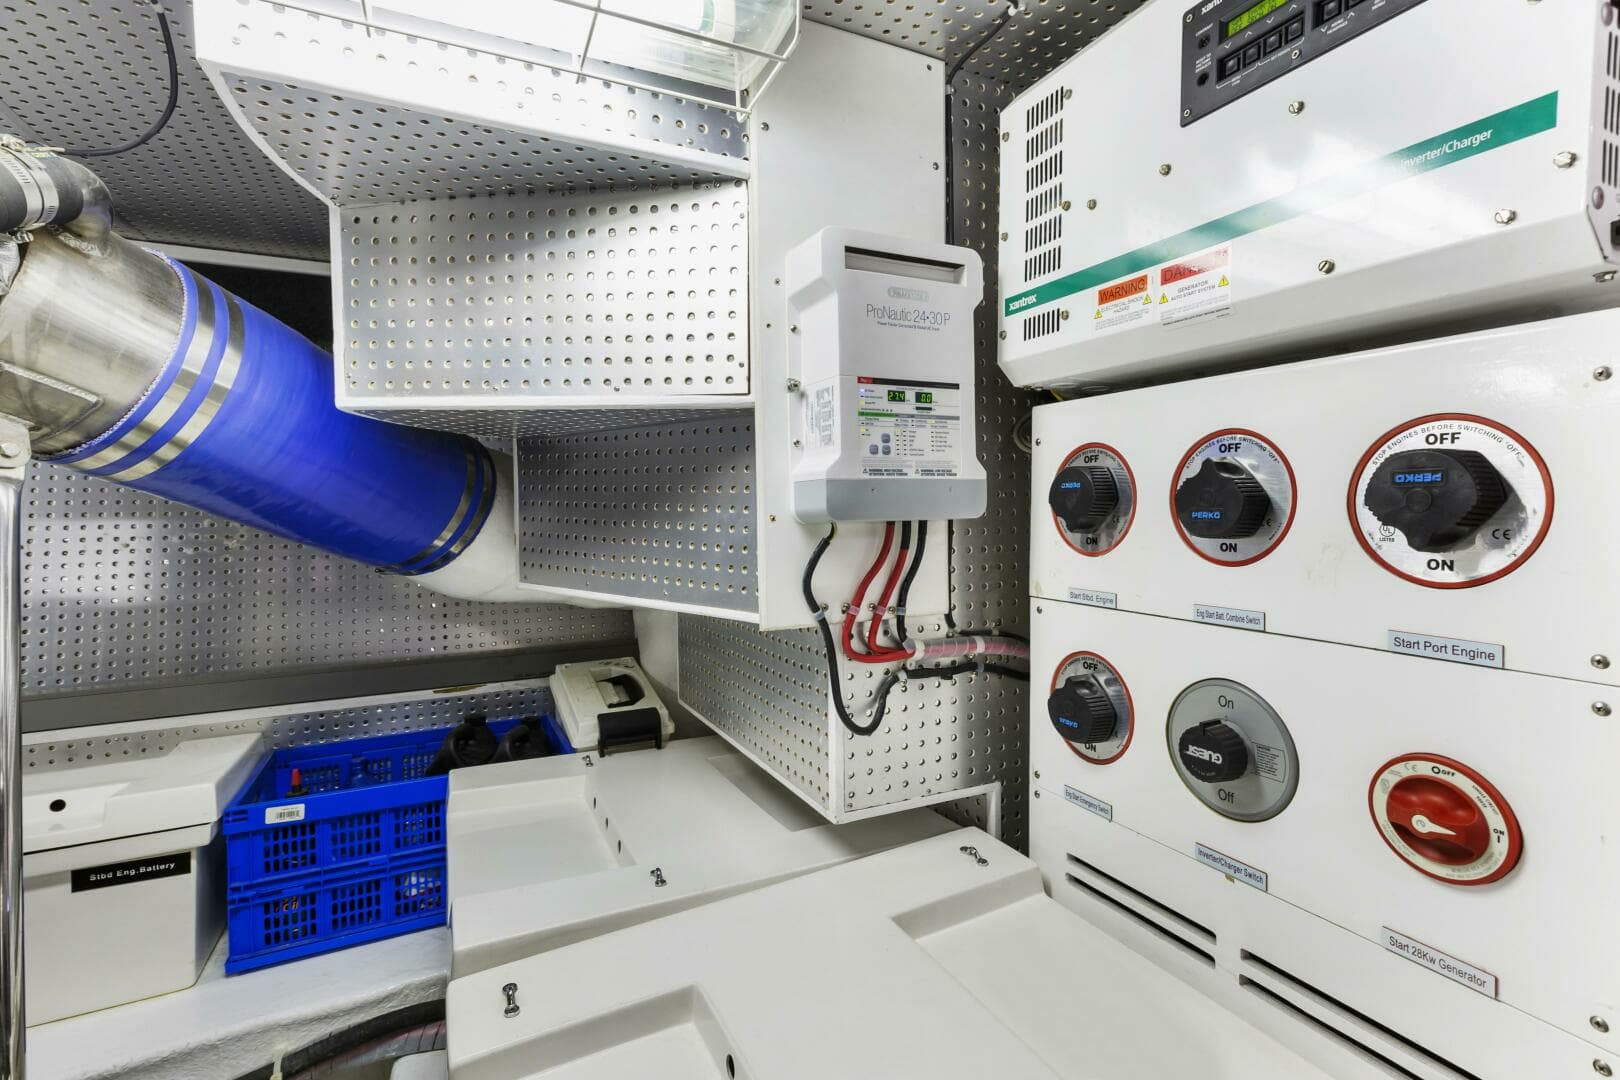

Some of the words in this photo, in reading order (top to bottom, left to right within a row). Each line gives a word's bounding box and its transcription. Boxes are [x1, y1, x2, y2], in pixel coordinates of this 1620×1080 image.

[1400, 129, 1493, 168] Inverter/Charger
[1100, 278, 1145, 301] WARNING
[1009, 294, 1037, 311] xantrex
[866, 304, 911, 321] ProNautic
[1372, 449, 1386, 466] STOP
[1387, 430, 1418, 451] ENGINES
[1421, 424, 1454, 434] BEFORE
[1457, 424, 1503, 443] SWITCHING
[1425, 432, 1461, 446] OFF
[1218, 443, 1241, 453] OFF
[1084, 455, 1099, 463] OFF
[1394, 472, 1443, 483] PERKO
[1191, 511, 1220, 519] PERKO
[1086, 536, 1098, 545] ON
[1220, 543, 1237, 552] ON
[1427, 558, 1454, 571] ON
[1095, 594, 1114, 605] Engine
[1197, 608, 1205, 619] Eng
[1245, 615, 1261, 625] Switch
[1393, 636, 1420, 650] Start
[1423, 640, 1448, 654] Port
[1451, 645, 1496, 661] Engine
[1083, 661, 1098, 671] OFF
[1218, 695, 1234, 709] On
[1085, 743, 1097, 752] ON
[1185, 745, 1223, 765] GUEST
[1441, 769, 1455, 777] OFF
[1218, 789, 1235, 803] Off
[1493, 828, 1505, 836] ON
[1198, 847, 1242, 875] Inverter/Charger
[1244, 868, 1264, 884] Switch
[89, 872, 113, 881] Stbd
[1389, 935, 1410, 953] Start
[1411, 945, 1436, 965] 28Kw
[1438, 958, 1487, 988] Generator
